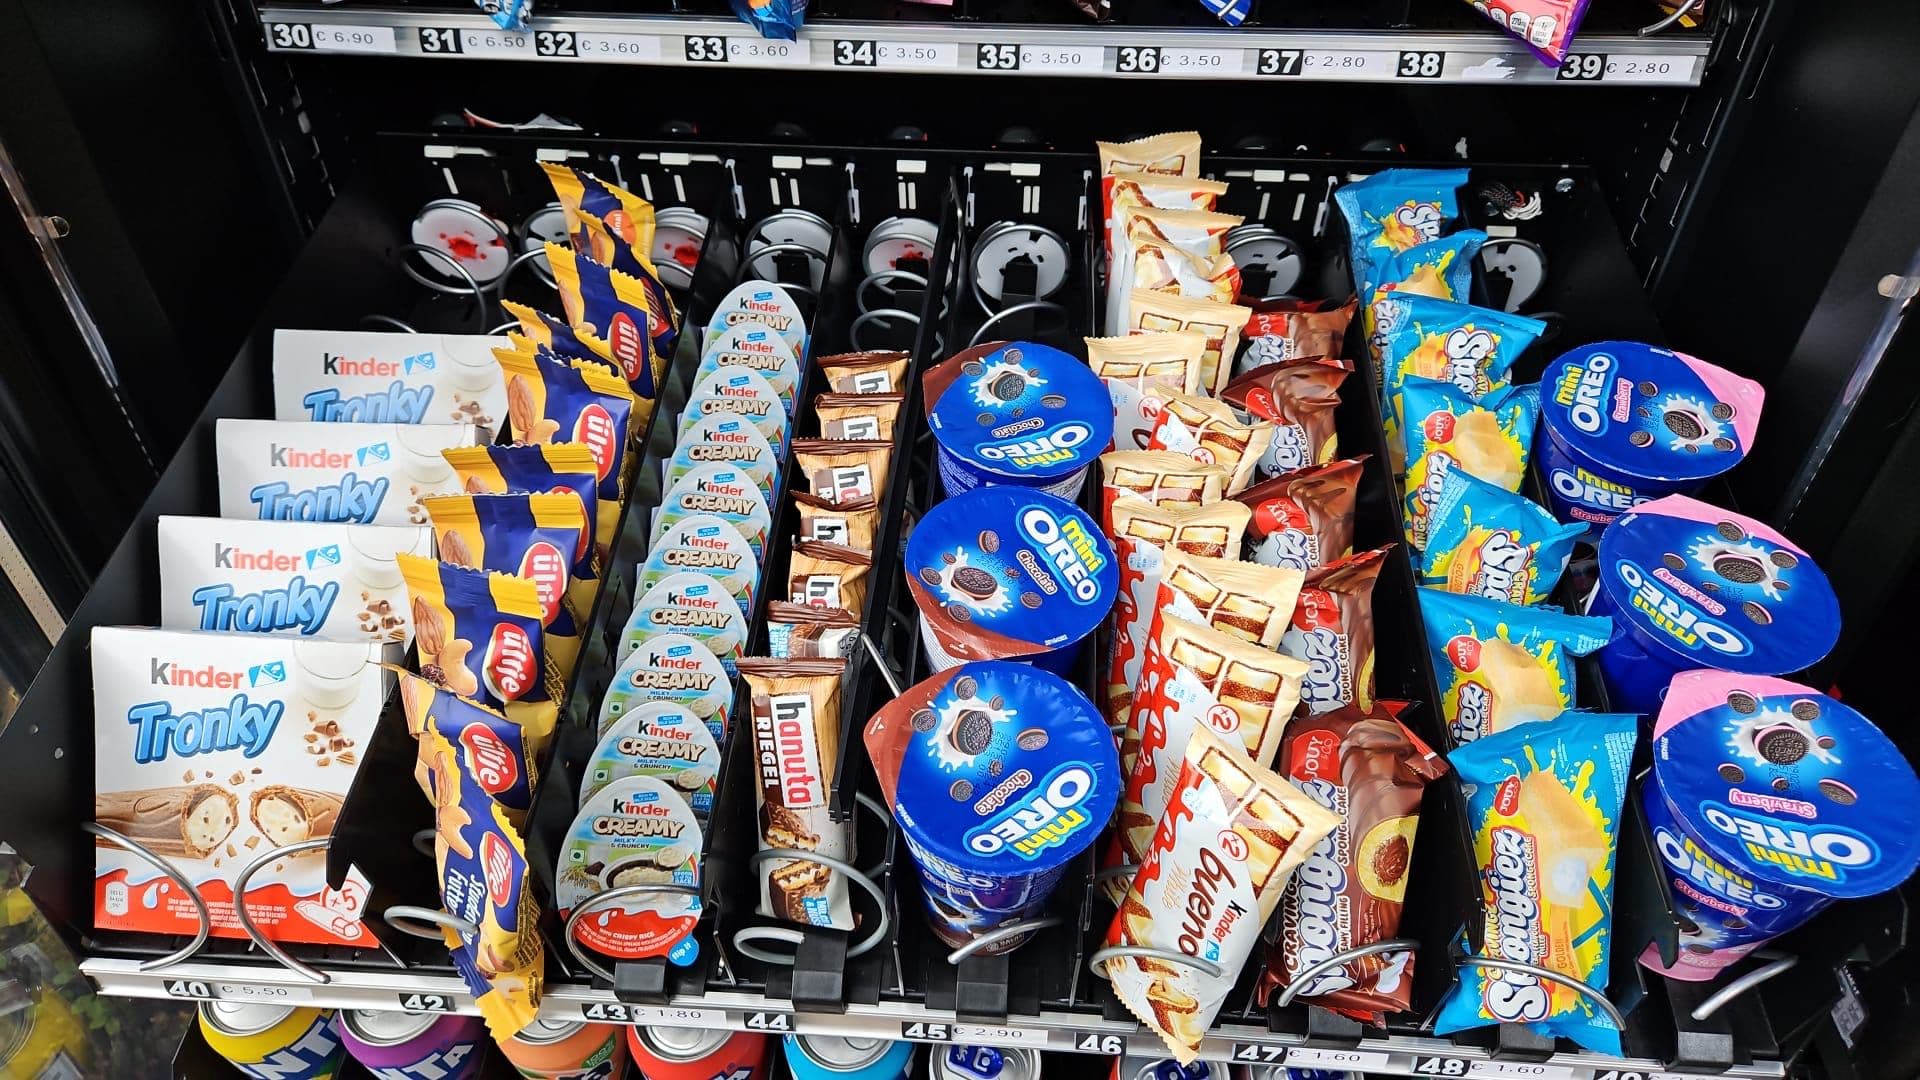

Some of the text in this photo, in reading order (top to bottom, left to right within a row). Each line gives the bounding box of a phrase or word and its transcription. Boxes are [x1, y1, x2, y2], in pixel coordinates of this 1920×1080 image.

[273, 24, 311, 48] 30
[335, 31, 373, 46] 6.90
[420, 29, 458, 53] 31
[485, 35, 526, 49] 6.50
[538, 32, 577, 56] 32
[600, 40, 641, 54] 3.60
[687, 36, 726, 60] 33
[749, 45, 789, 58] 3.60
[837, 41, 876, 64] 34
[896, 47, 937, 60] 3.50
[980, 45, 1019, 69] 35
[1041, 53, 1081, 65] 3.50
[1119, 48, 1157, 71] 36
[1179, 55, 1221, 67] 3.50
[1260, 50, 1299, 73] 37
[1323, 56, 1366, 67] 2.80
[1400, 52, 1440, 76] 38
[1561, 55, 1602, 79] 39
[1625, 63, 1670, 74] 2.80
[717, 352, 785, 371] CREAMY
[1557, 365, 1584, 406] mini
[1571, 355, 1611, 433] OREO
[303, 381, 433, 424] Tronky
[700, 399, 771, 417] CREAMY
[688, 445, 762, 463] CREAMY
[981, 425, 1089, 460] OREO
[1013, 449, 1073, 467] mini
[1577, 467, 1633, 499] mini
[251, 472, 389, 525] Tronky
[680, 493, 756, 515] CREAMY
[1023, 510, 1097, 601] OREO
[1060, 520, 1102, 572] mini
[1309, 535, 1319, 564] CAKE
[663, 549, 742, 569] CREAMY
[1016, 550, 1057, 595] Chocolate
[1653, 568, 1726, 616] Strawberry
[192, 575, 340, 634] Tronky
[1620, 563, 1744, 652] OREO
[650, 608, 732, 629] CREAMY
[1632, 594, 1697, 646] mini
[1457, 638, 1469, 670] JOUY
[630, 669, 716, 690] CREAMY
[1338, 634, 1351, 703] SPONGE CAKE
[127, 694, 285, 764] Tronky
[618, 736, 706, 762] CREAMY
[756, 716, 779, 789] RIEGEL
[775, 702, 812, 804] hanuta
[1304, 735, 1324, 777] JOUY
[974, 769, 1032, 815] Chocolate
[1338, 787, 1347, 820] CAKE
[1729, 789, 1817, 818] Strawberry
[970, 767, 1091, 853] OREO
[592, 816, 685, 839] CREAMY
[1014, 809, 1085, 854] mini
[1706, 807, 1871, 865] OREO
[1657, 828, 1781, 910] OREO
[1685, 839, 1754, 891] mini
[1746, 842, 1837, 880] mini
[1178, 847, 1237, 956] bueno
[1675, 878, 1748, 915] Strawberry
[1339, 895, 1350, 930] FILLING
[169, 980, 210, 997] 40
[242, 986, 287, 996] 5.50
[404, 994, 444, 1011] 42
[586, 1004, 628, 1020] 43
[658, 1009, 701, 1018] 1.80
[747, 1012, 790, 1030] 44
[905, 1023, 947, 1039] 45
[975, 1027, 1023, 1038] 2.90
[1079, 1034, 1122, 1055] 46
[1237, 1044, 1284, 1061] 47
[1312, 1052, 1360, 1061] 1.60
[1418, 1057, 1464, 1075] 48
[1499, 1065, 1545, 1075] 1.60
